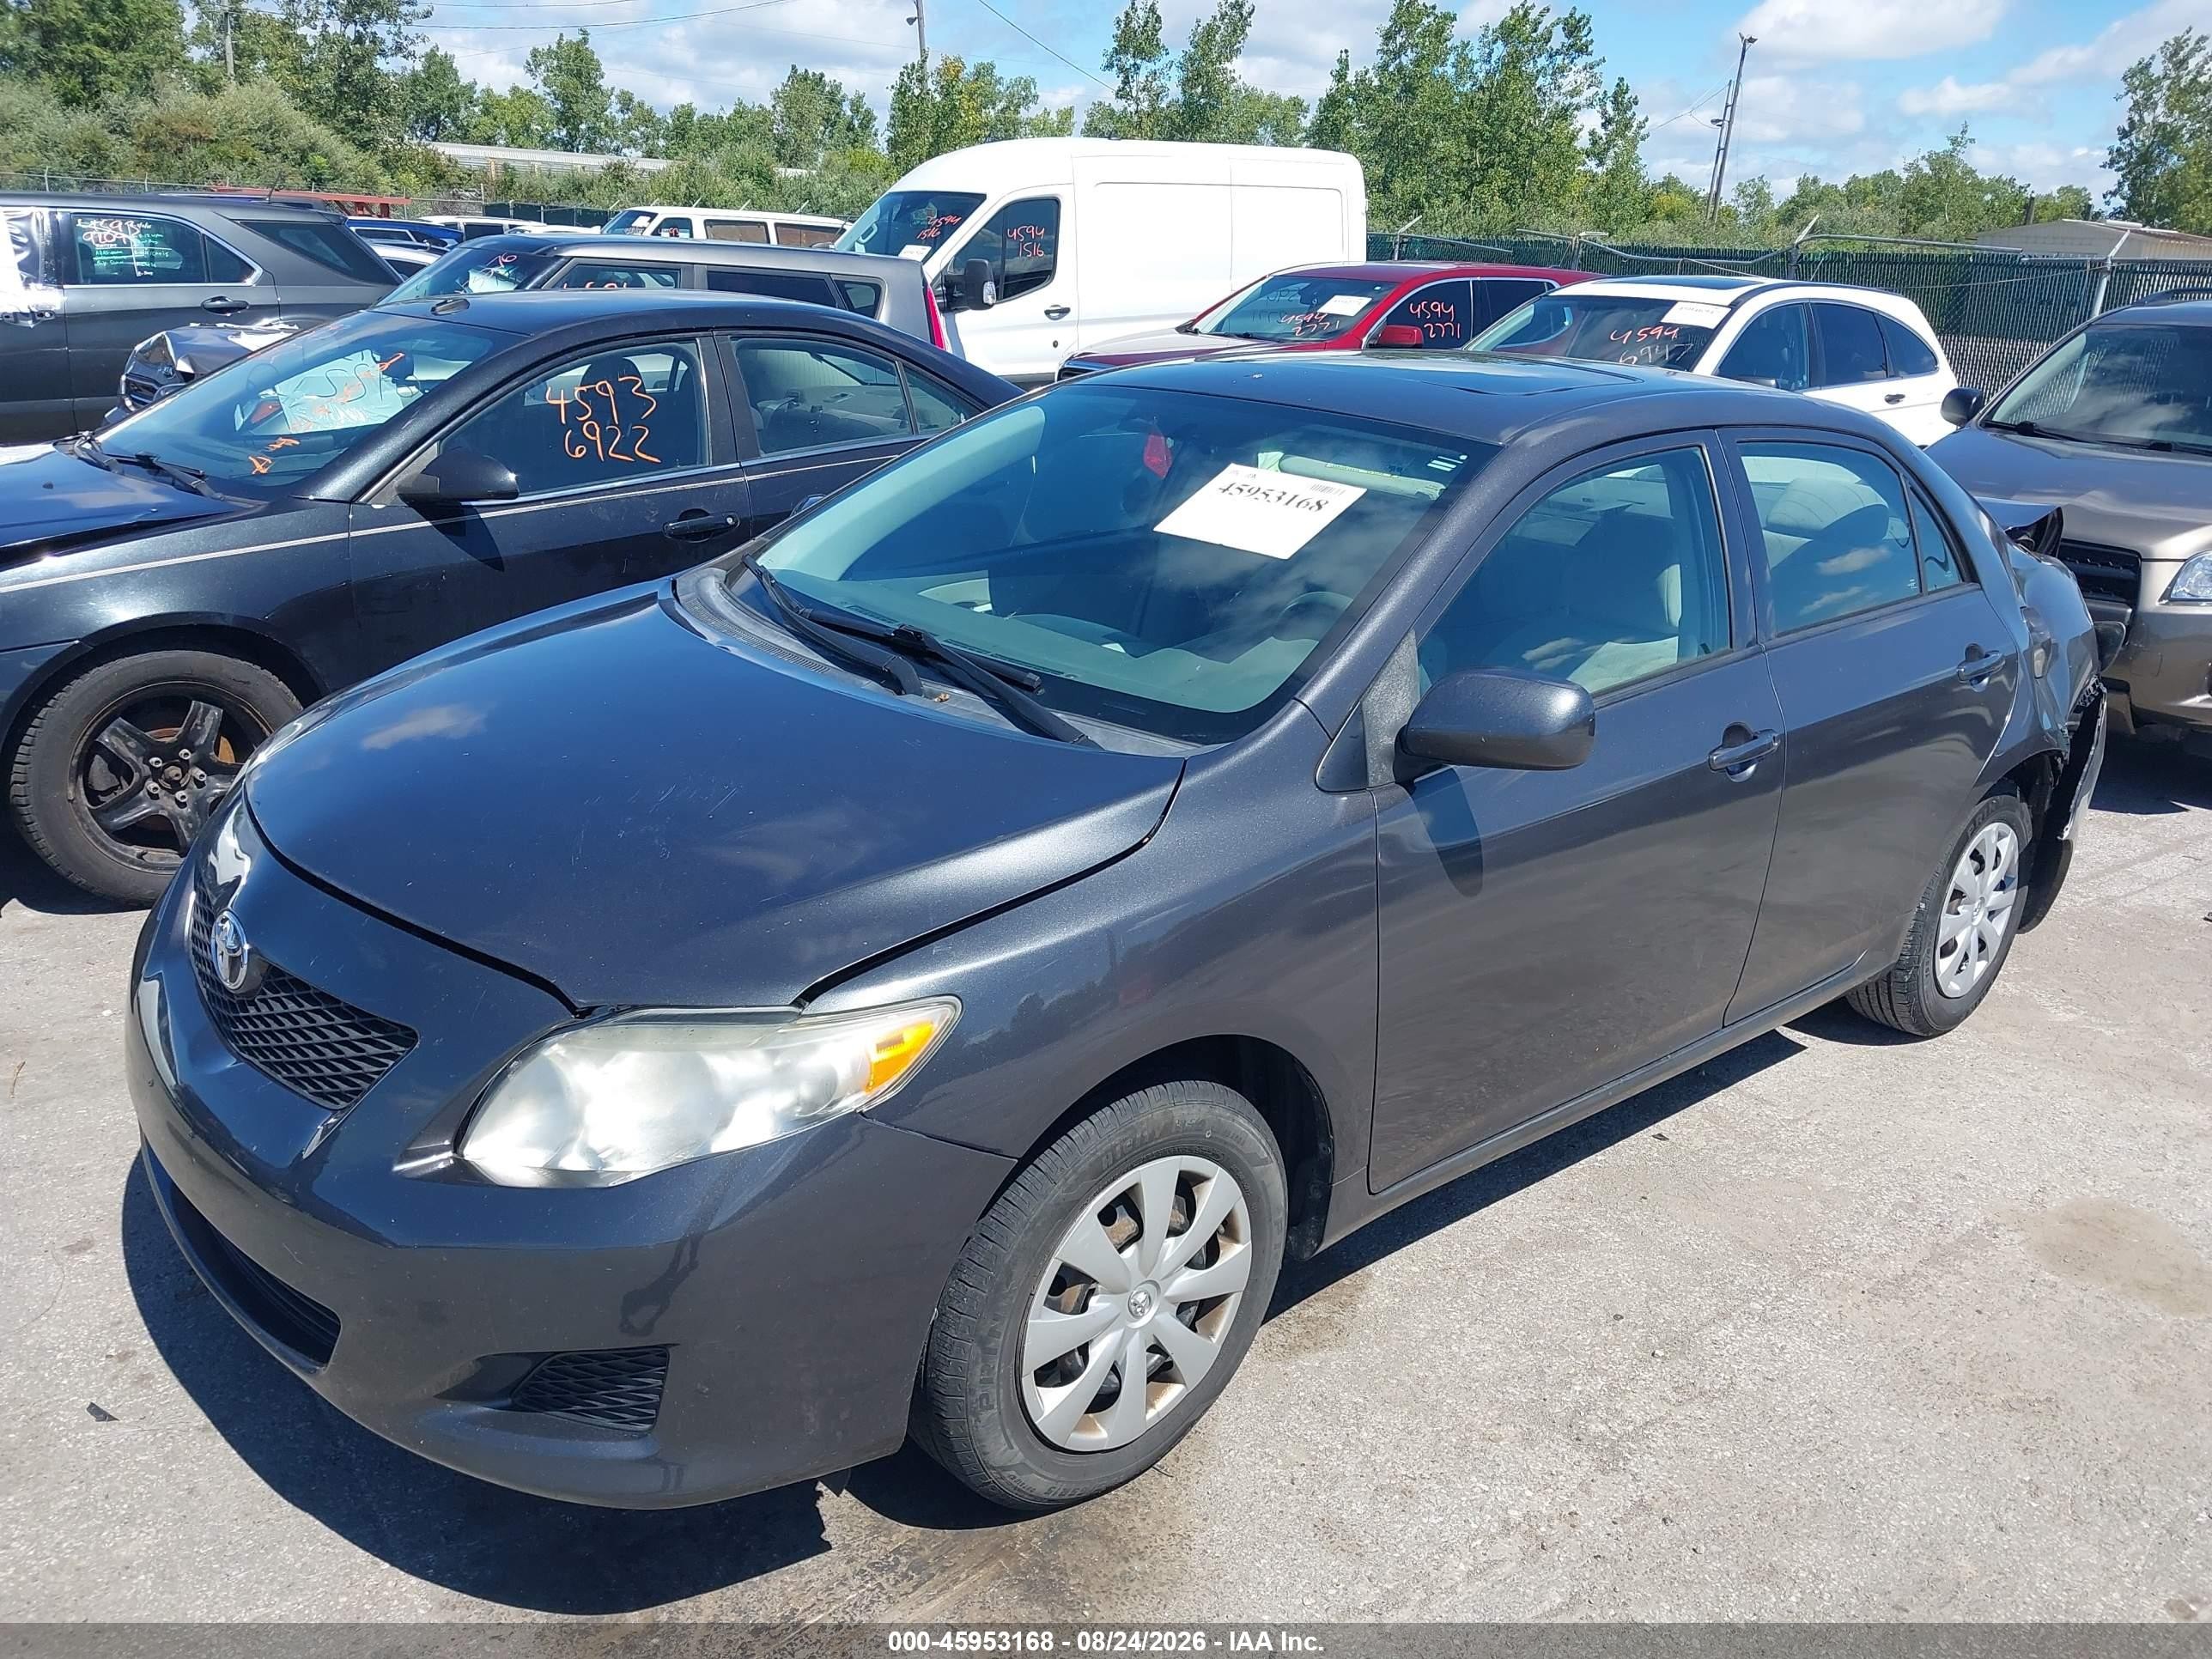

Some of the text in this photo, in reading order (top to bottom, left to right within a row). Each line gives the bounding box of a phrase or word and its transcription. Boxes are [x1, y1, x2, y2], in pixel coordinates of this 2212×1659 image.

[916, 226, 941, 240] 1516
[1006, 225, 1045, 241] 4594
[1018, 241, 1044, 258] 1516
[1280, 312, 1328, 324] 4594
[1409, 301, 1455, 322] 4594
[1291, 319, 1340, 337] 2771
[1423, 322, 1461, 339] 2771
[1610, 325, 1680, 344] 4594
[545, 376, 657, 424] 4593
[564, 421, 661, 464] 6922
[1218, 482, 1329, 513] 45953168
